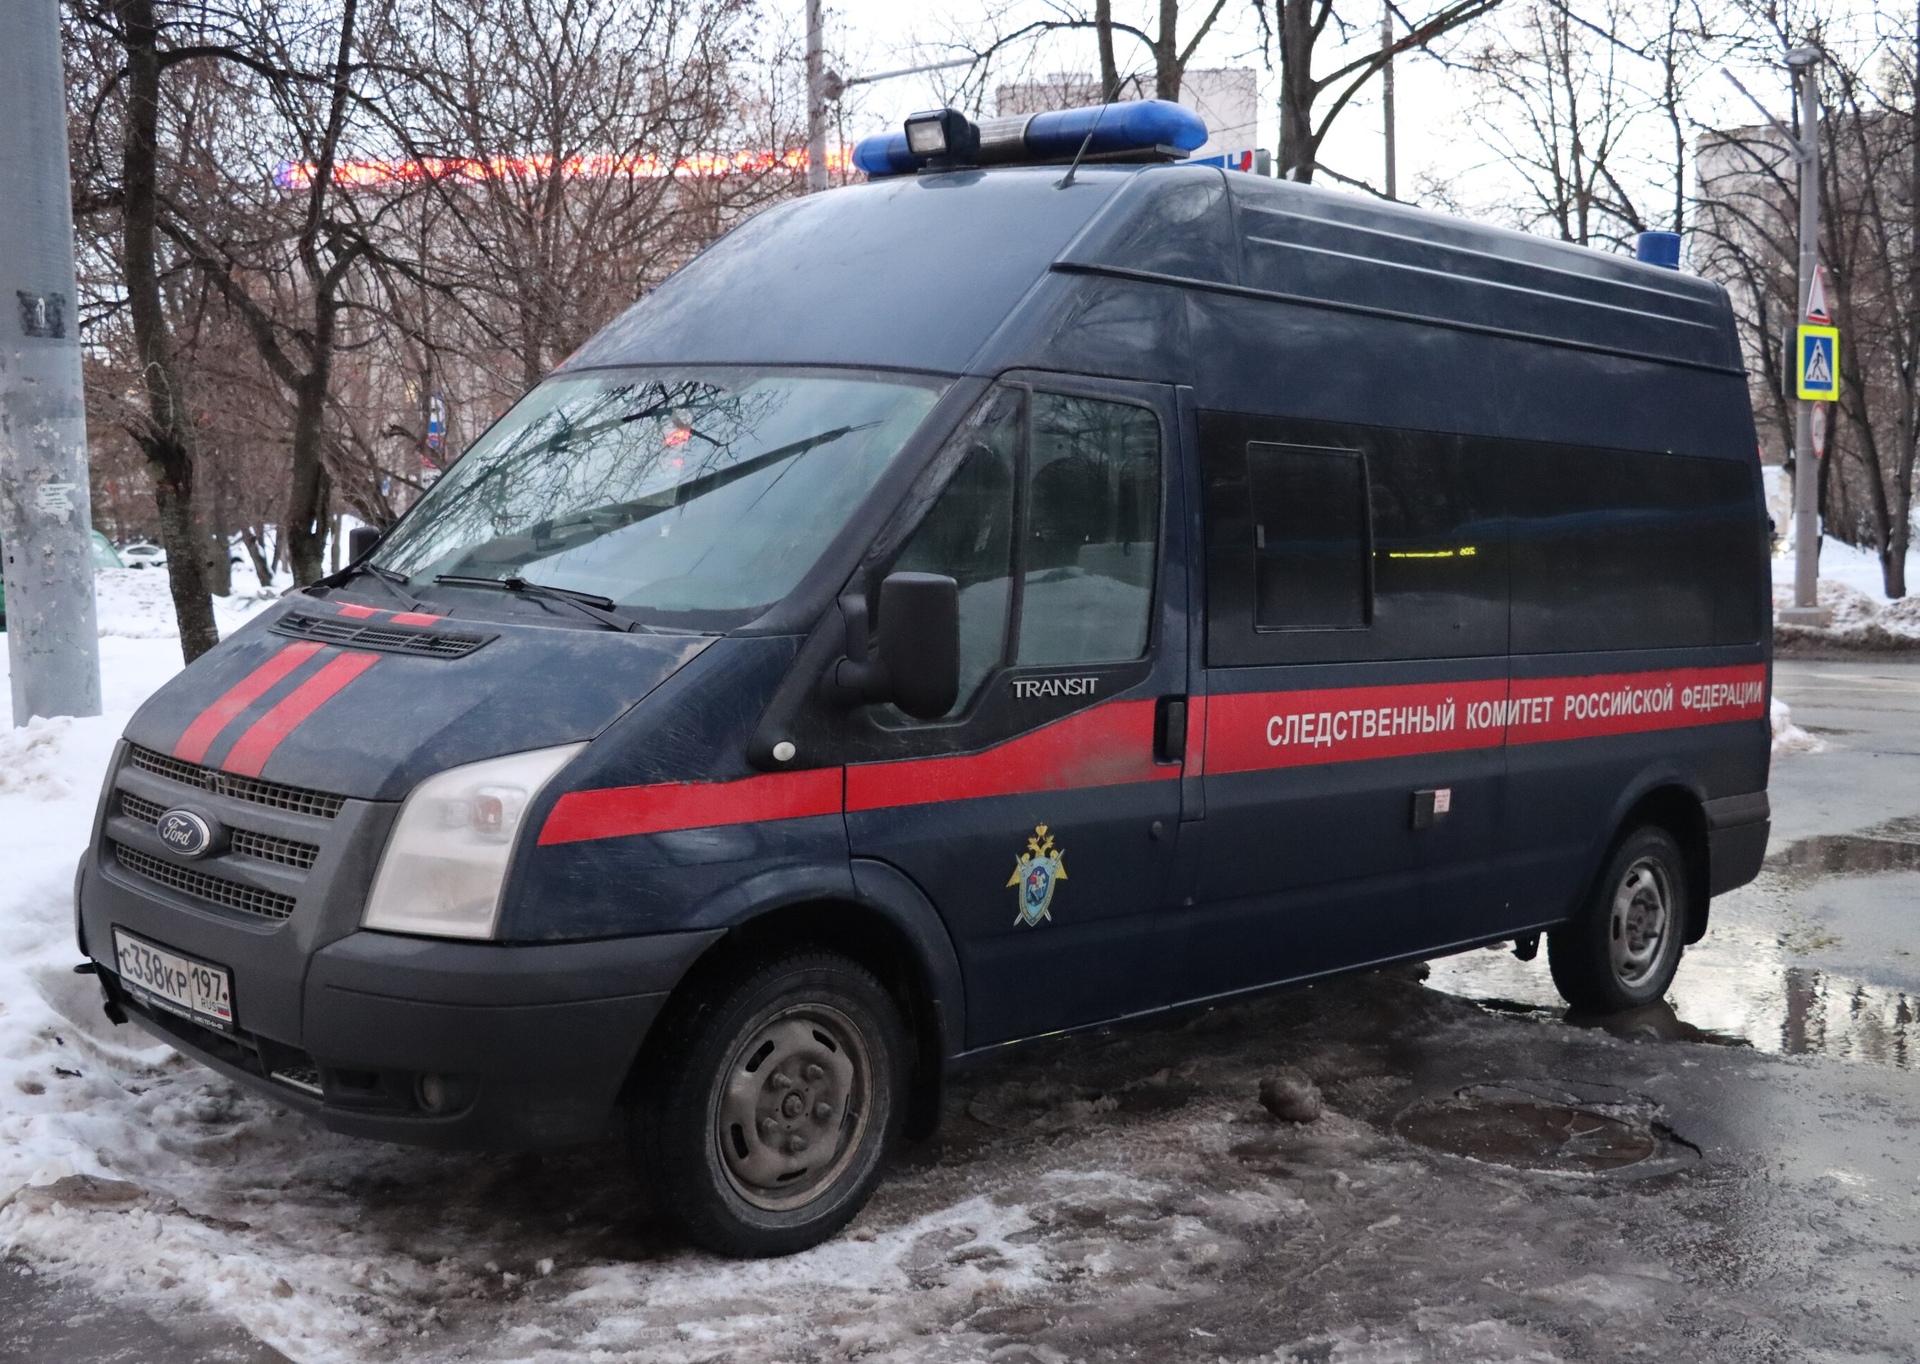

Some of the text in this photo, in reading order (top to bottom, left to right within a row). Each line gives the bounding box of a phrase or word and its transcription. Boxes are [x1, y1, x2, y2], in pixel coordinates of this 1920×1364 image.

[1012, 678, 1099, 698] TRANSIT
[1266, 681, 1763, 748] СЛЕДСТВЕННЫЙ КОМИТЕТ РОССИЙСКОЙ ФЕДЕРАЦИИ
[163, 816, 193, 846] Ford
[191, 967, 221, 1001] 197
[201, 998, 217, 1012] RUS
